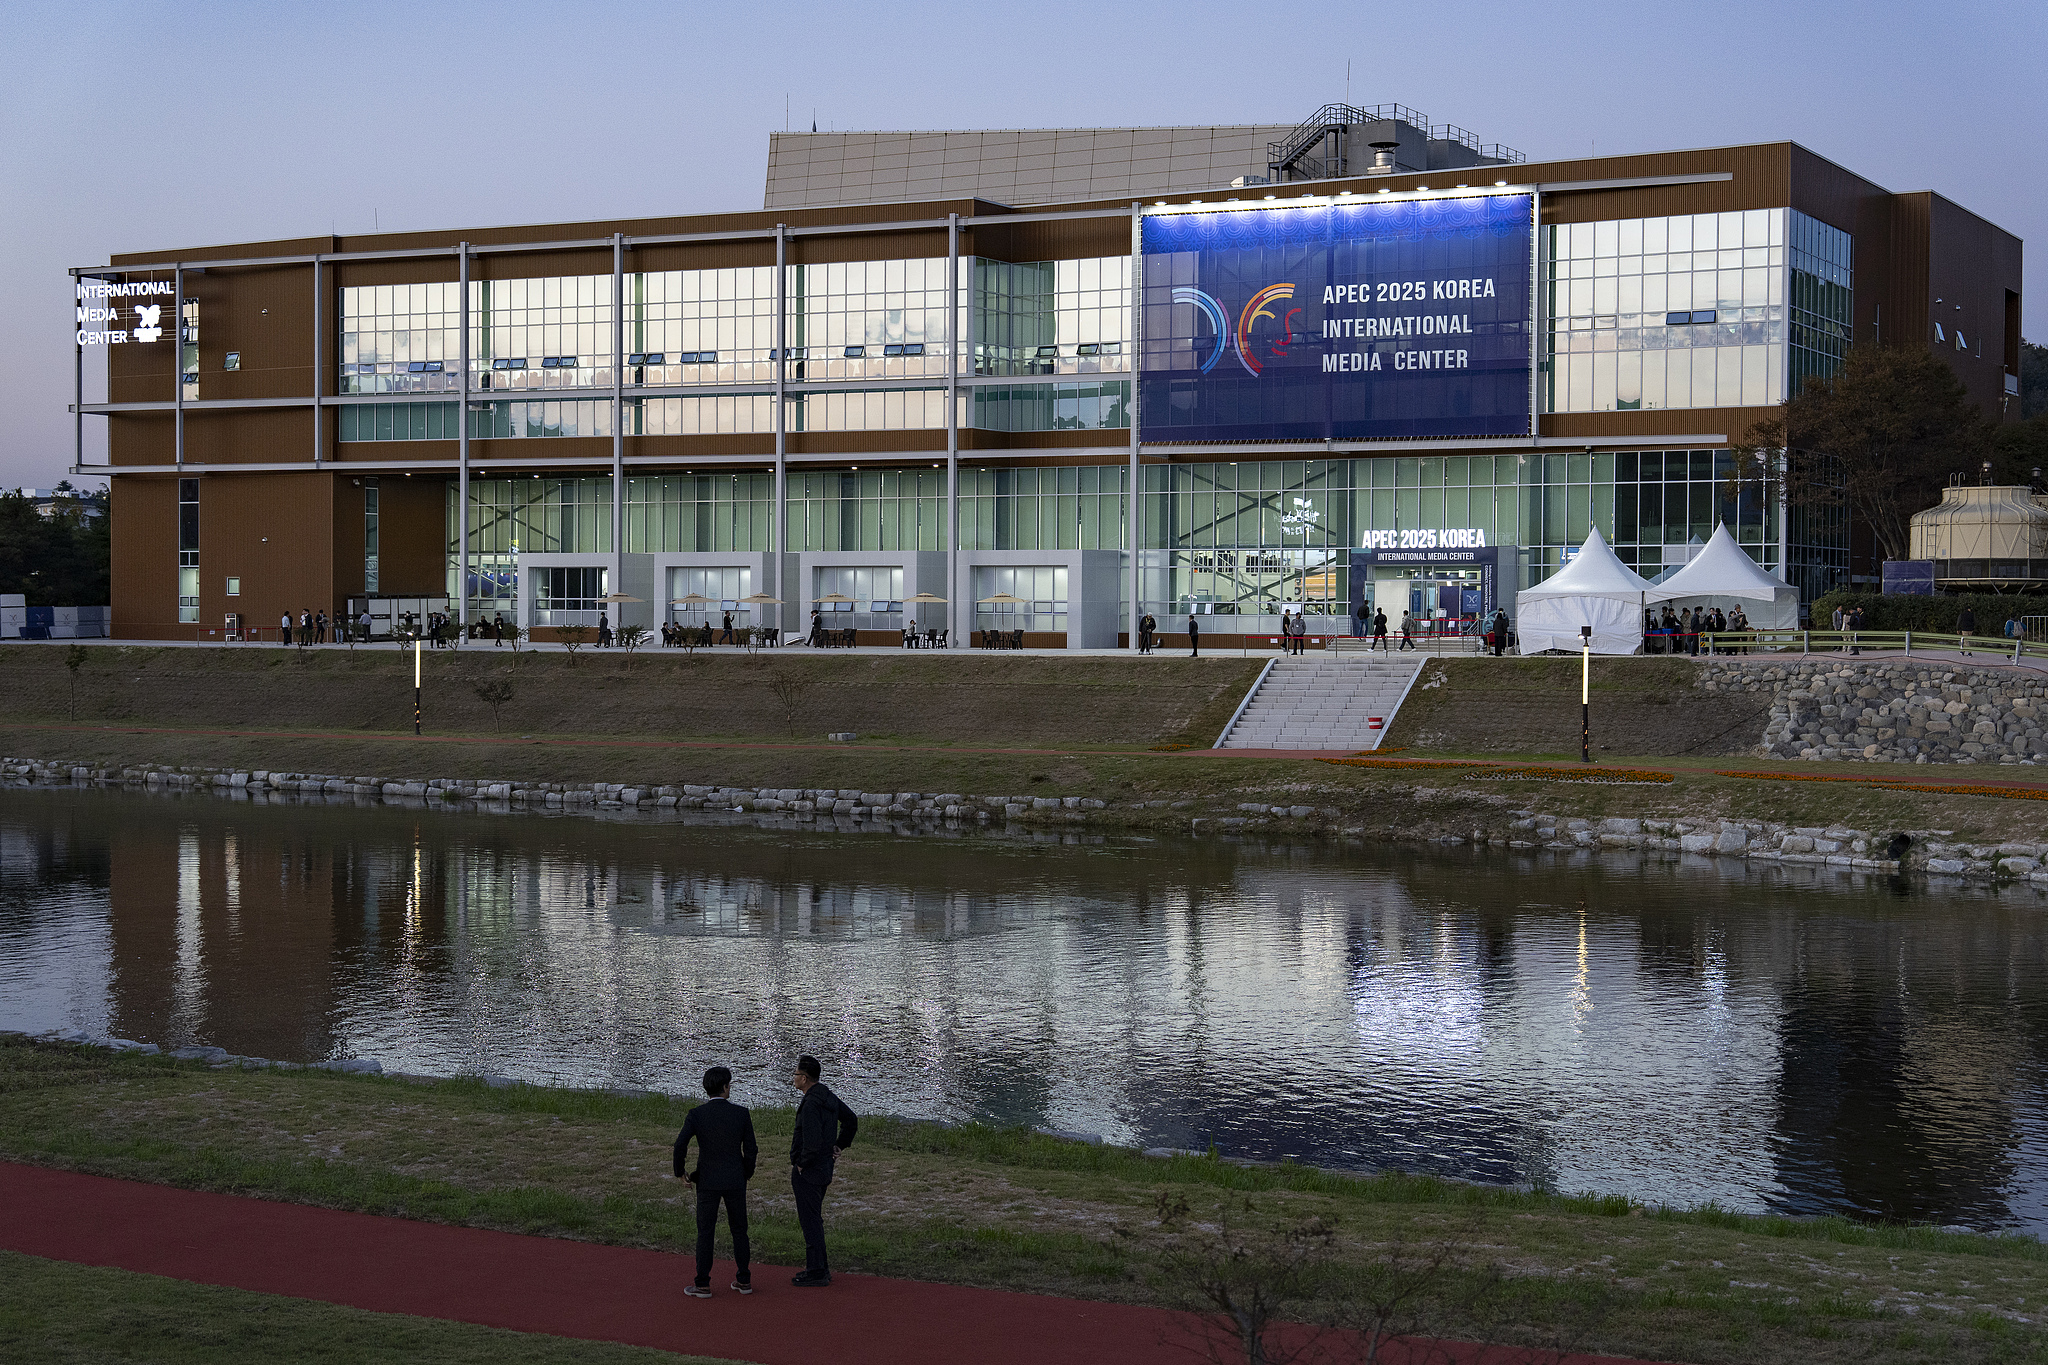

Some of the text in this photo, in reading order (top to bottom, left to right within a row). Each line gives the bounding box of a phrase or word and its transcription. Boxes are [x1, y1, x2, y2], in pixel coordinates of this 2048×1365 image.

[76, 281, 175, 300] INTERNATIONAL
[1322, 278, 1496, 304] APEC 2025 KOREA
[76, 306, 118, 323] MEDIA
[1322, 314, 1473, 339] INTERNATIONAL
[76, 329, 128, 346] CENTER
[1322, 349, 1468, 373] MEDIA CENTER
[1362, 529, 1398, 549] APEC
[1400, 529, 1437, 549] 2025
[1439, 528, 1486, 548] KOREA
[1377, 552, 1475, 561] INTERNATIONAL MEDIA CENTER
